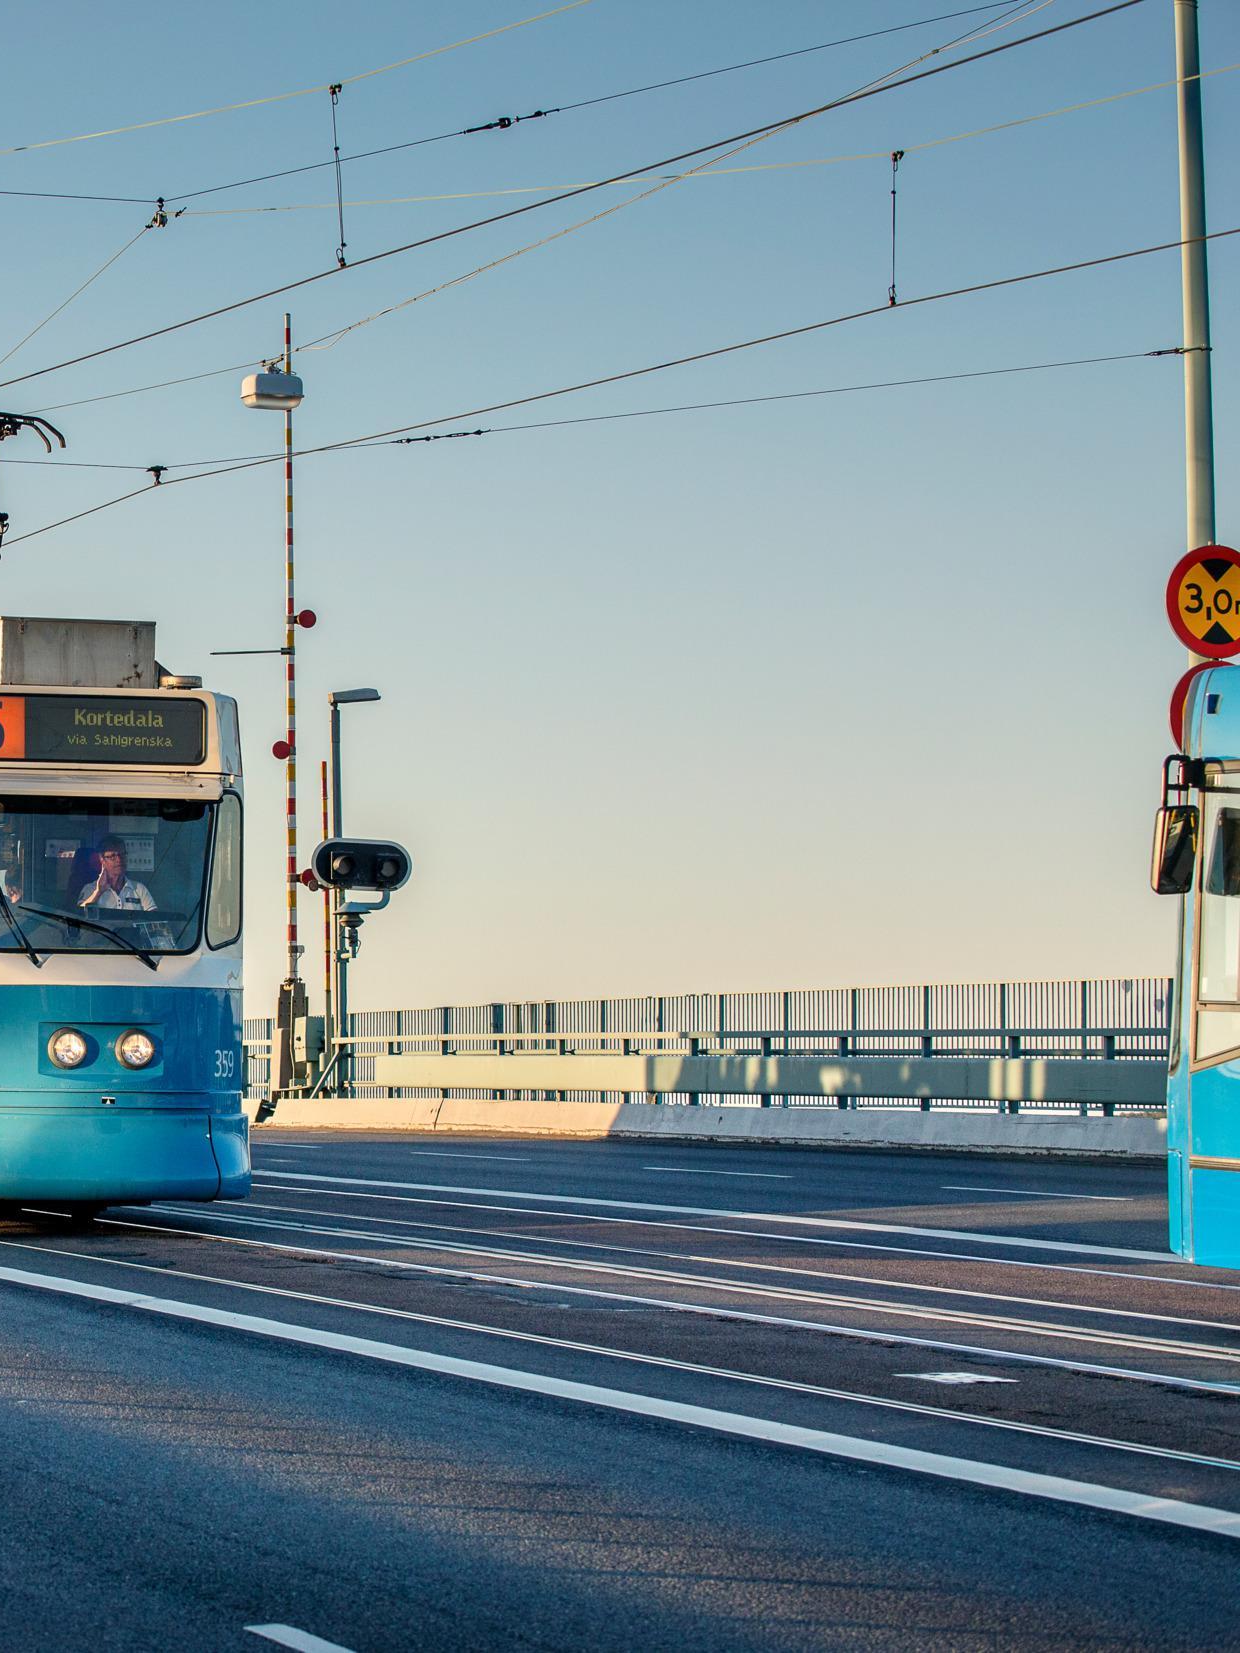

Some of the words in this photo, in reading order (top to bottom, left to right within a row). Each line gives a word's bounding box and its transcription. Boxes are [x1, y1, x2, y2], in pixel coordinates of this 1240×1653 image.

[1184, 583, 1240, 620] 3,0
[74, 708, 164, 728] Kortedala
[94, 734, 173, 748] Sahlgrenska
[214, 1049, 234, 1078] 359
